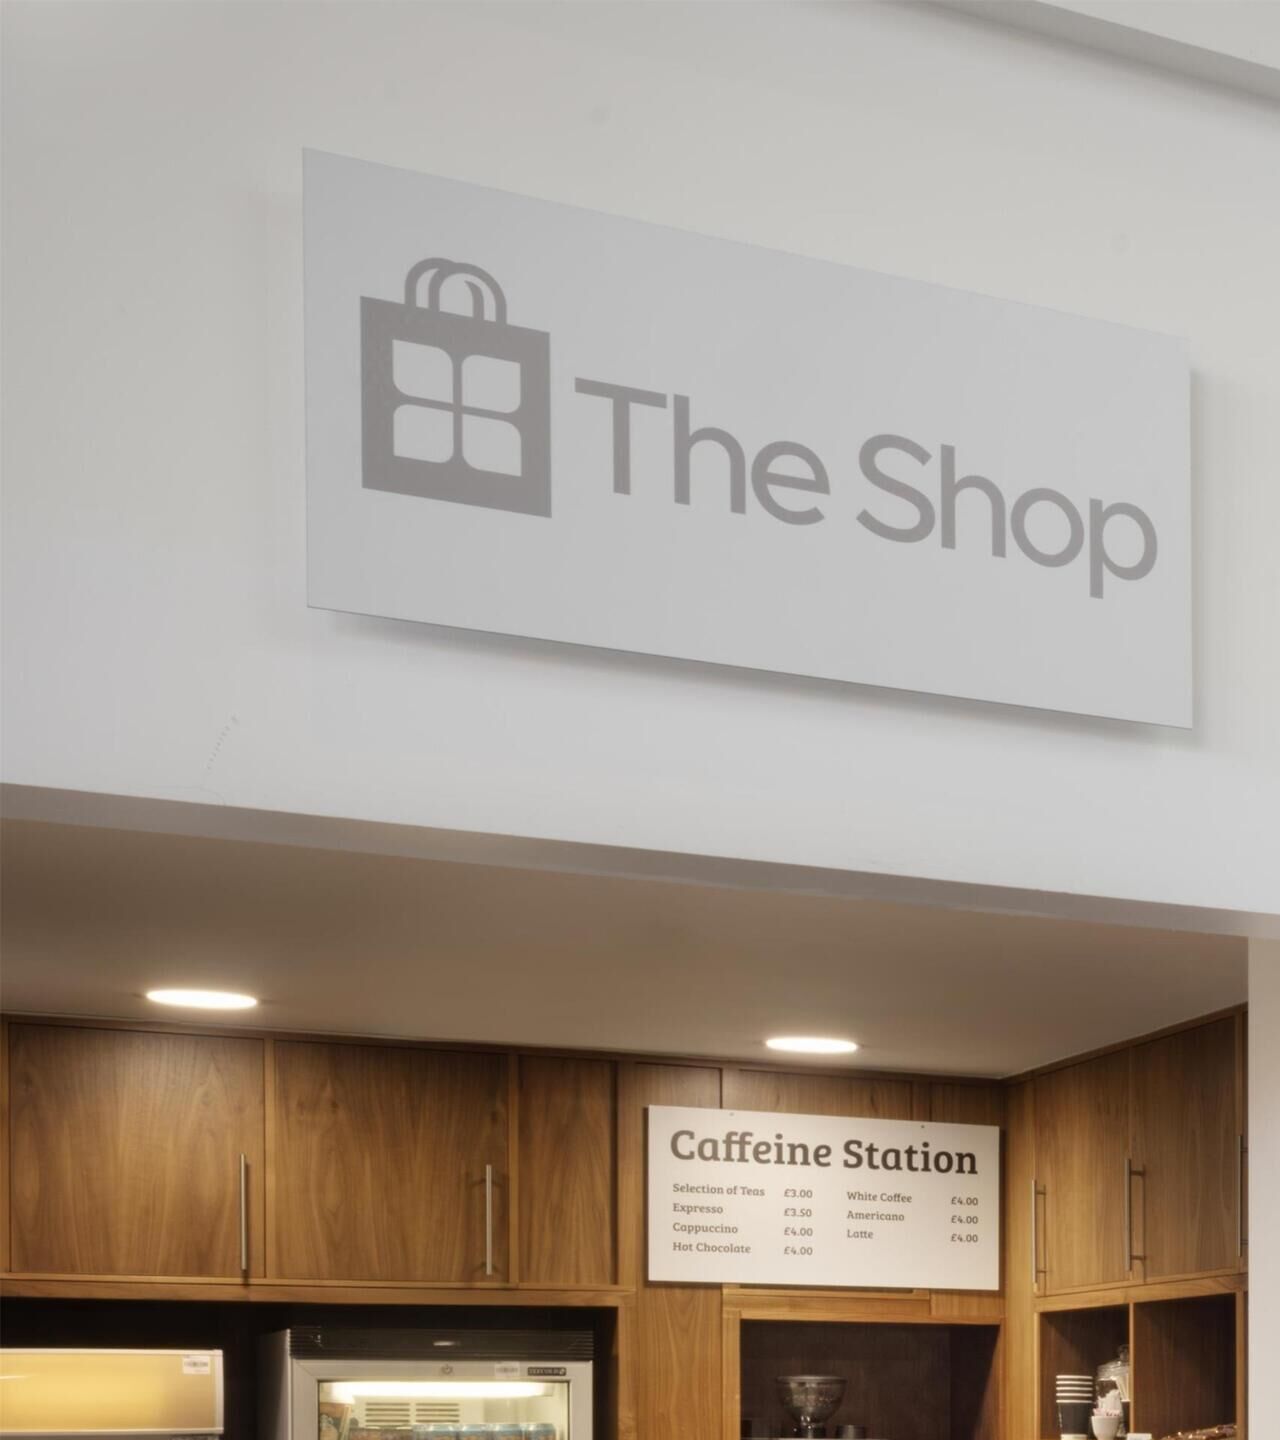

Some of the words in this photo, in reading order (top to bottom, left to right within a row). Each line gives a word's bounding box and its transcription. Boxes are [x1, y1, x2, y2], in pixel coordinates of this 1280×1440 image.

[574, 377, 831, 526] The
[856, 434, 1158, 600] Shop
[670, 1130, 832, 1167] Caffeine
[843, 1139, 978, 1175] Station
[672, 1183, 724, 1195] Selection
[726, 1185, 738, 1195] of
[740, 1186, 765, 1197] Teas
[783, 1188, 813, 1199] £3.00
[847, 1191, 878, 1202] White
[880, 1192, 912, 1203] Coffee
[951, 1196, 979, 1206] £4.00
[672, 1202, 724, 1215] Expresso
[783, 1207, 812, 1218] £3.50
[846, 1210, 905, 1222] Americano
[951, 1215, 979, 1225] £4.00
[672, 1222, 738, 1235] Cappuccino
[783, 1226, 814, 1237] £4.00
[847, 1229, 874, 1239] Latte
[951, 1233, 979, 1243] £4.00
[672, 1241, 693, 1252] Hot
[696, 1242, 752, 1254] Chocolate
[783, 1246, 814, 1256] £4.00
